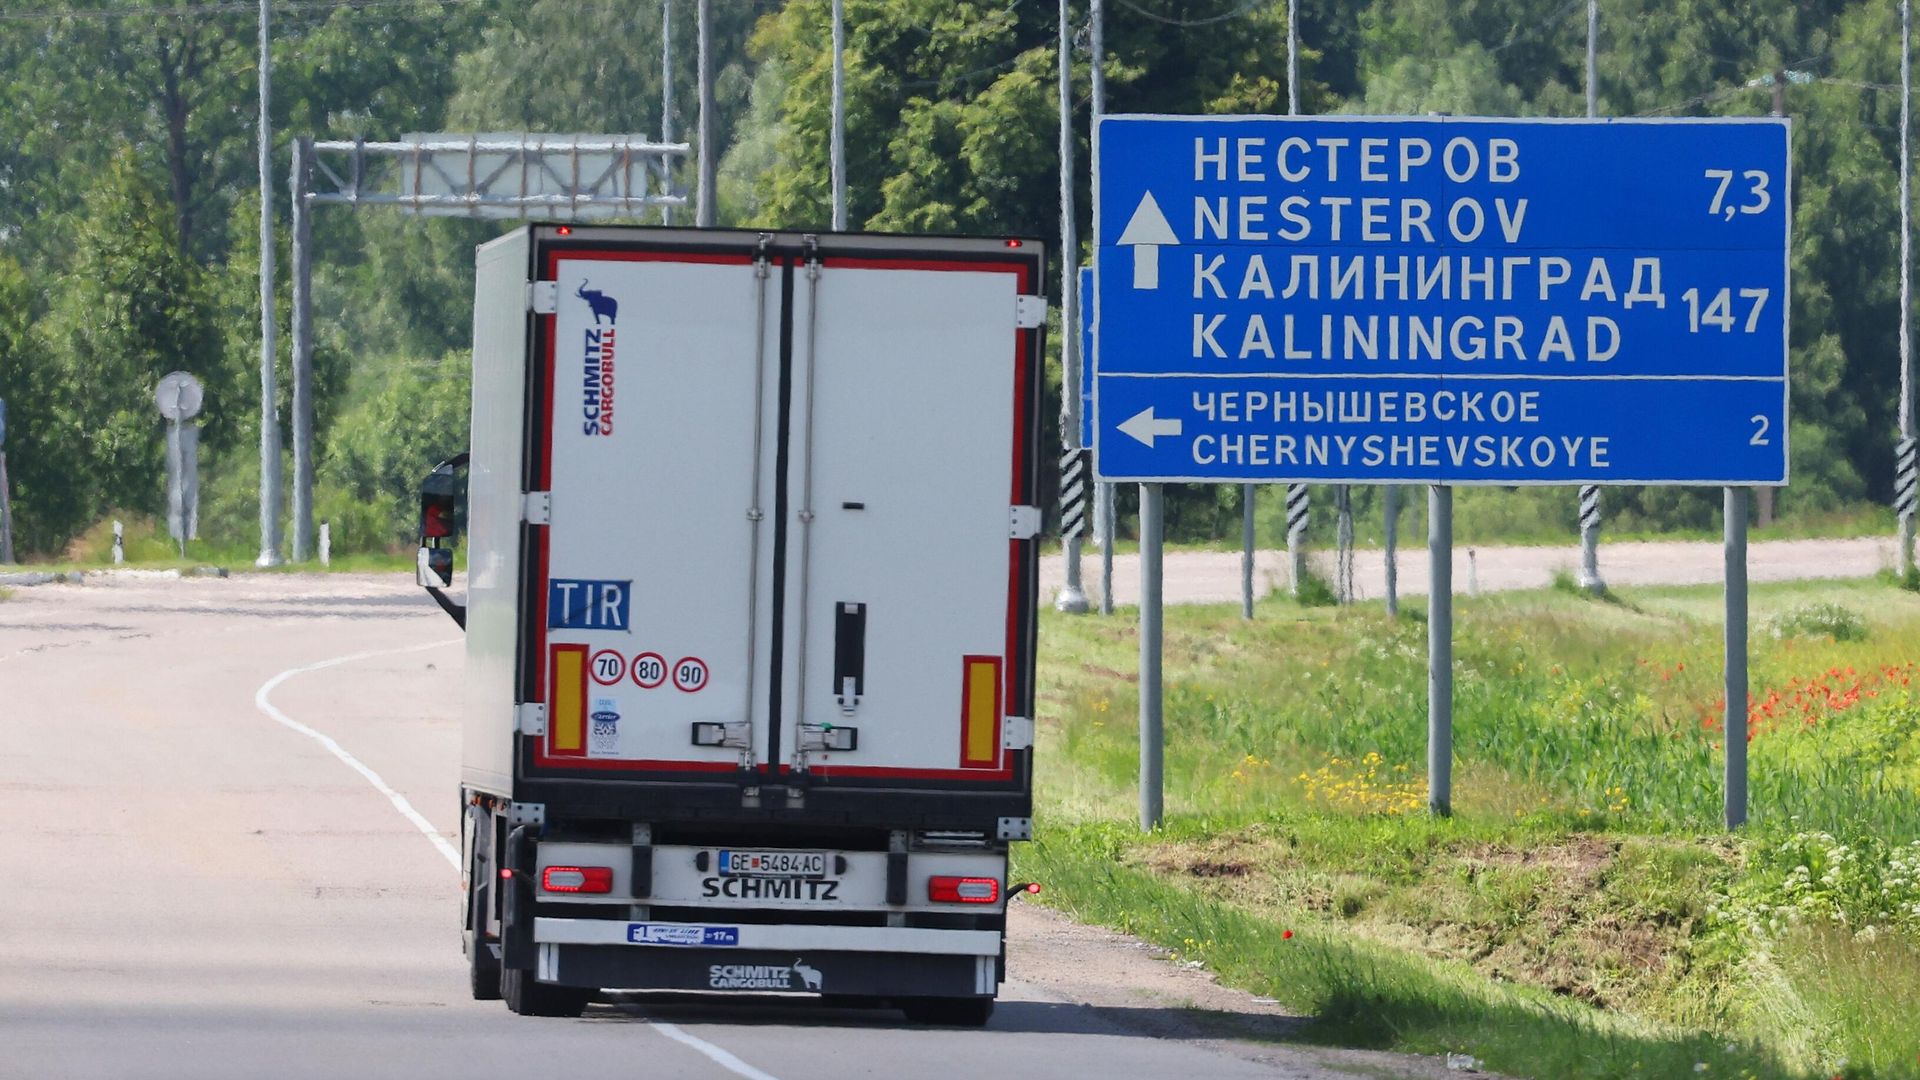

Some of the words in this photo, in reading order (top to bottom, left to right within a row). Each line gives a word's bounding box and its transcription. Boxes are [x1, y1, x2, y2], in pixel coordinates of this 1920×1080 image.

[1194, 136, 1521, 184] НЕСТЕРОВ
[1704, 169, 1771, 222] 7,3
[1194, 195, 1528, 243] NESTEROV
[1193, 253, 1666, 309] КАЛИНИНГРАД
[1681, 287, 1770, 334] 147
[1192, 313, 1622, 363] KALININGRAD
[584, 328, 602, 437] SCHMITZ
[600, 328, 616, 437] CARGOBULL
[1193, 390, 1541, 424] ЧЕРНЫШЕВСКОЕ
[1749, 414, 1770, 446] 2
[1192, 434, 1611, 468] CHERNYSHEVSKOYE
[556, 582, 623, 627] TIR
[597, 657, 619, 677] 70
[639, 661, 660, 680] 80
[680, 665, 702, 685] 90
[731, 854, 751, 871] GE
[702, 877, 839, 901] SCHMITZ
[709, 964, 792, 979] SCHMITZ
[709, 977, 792, 989] CARGOBULL
